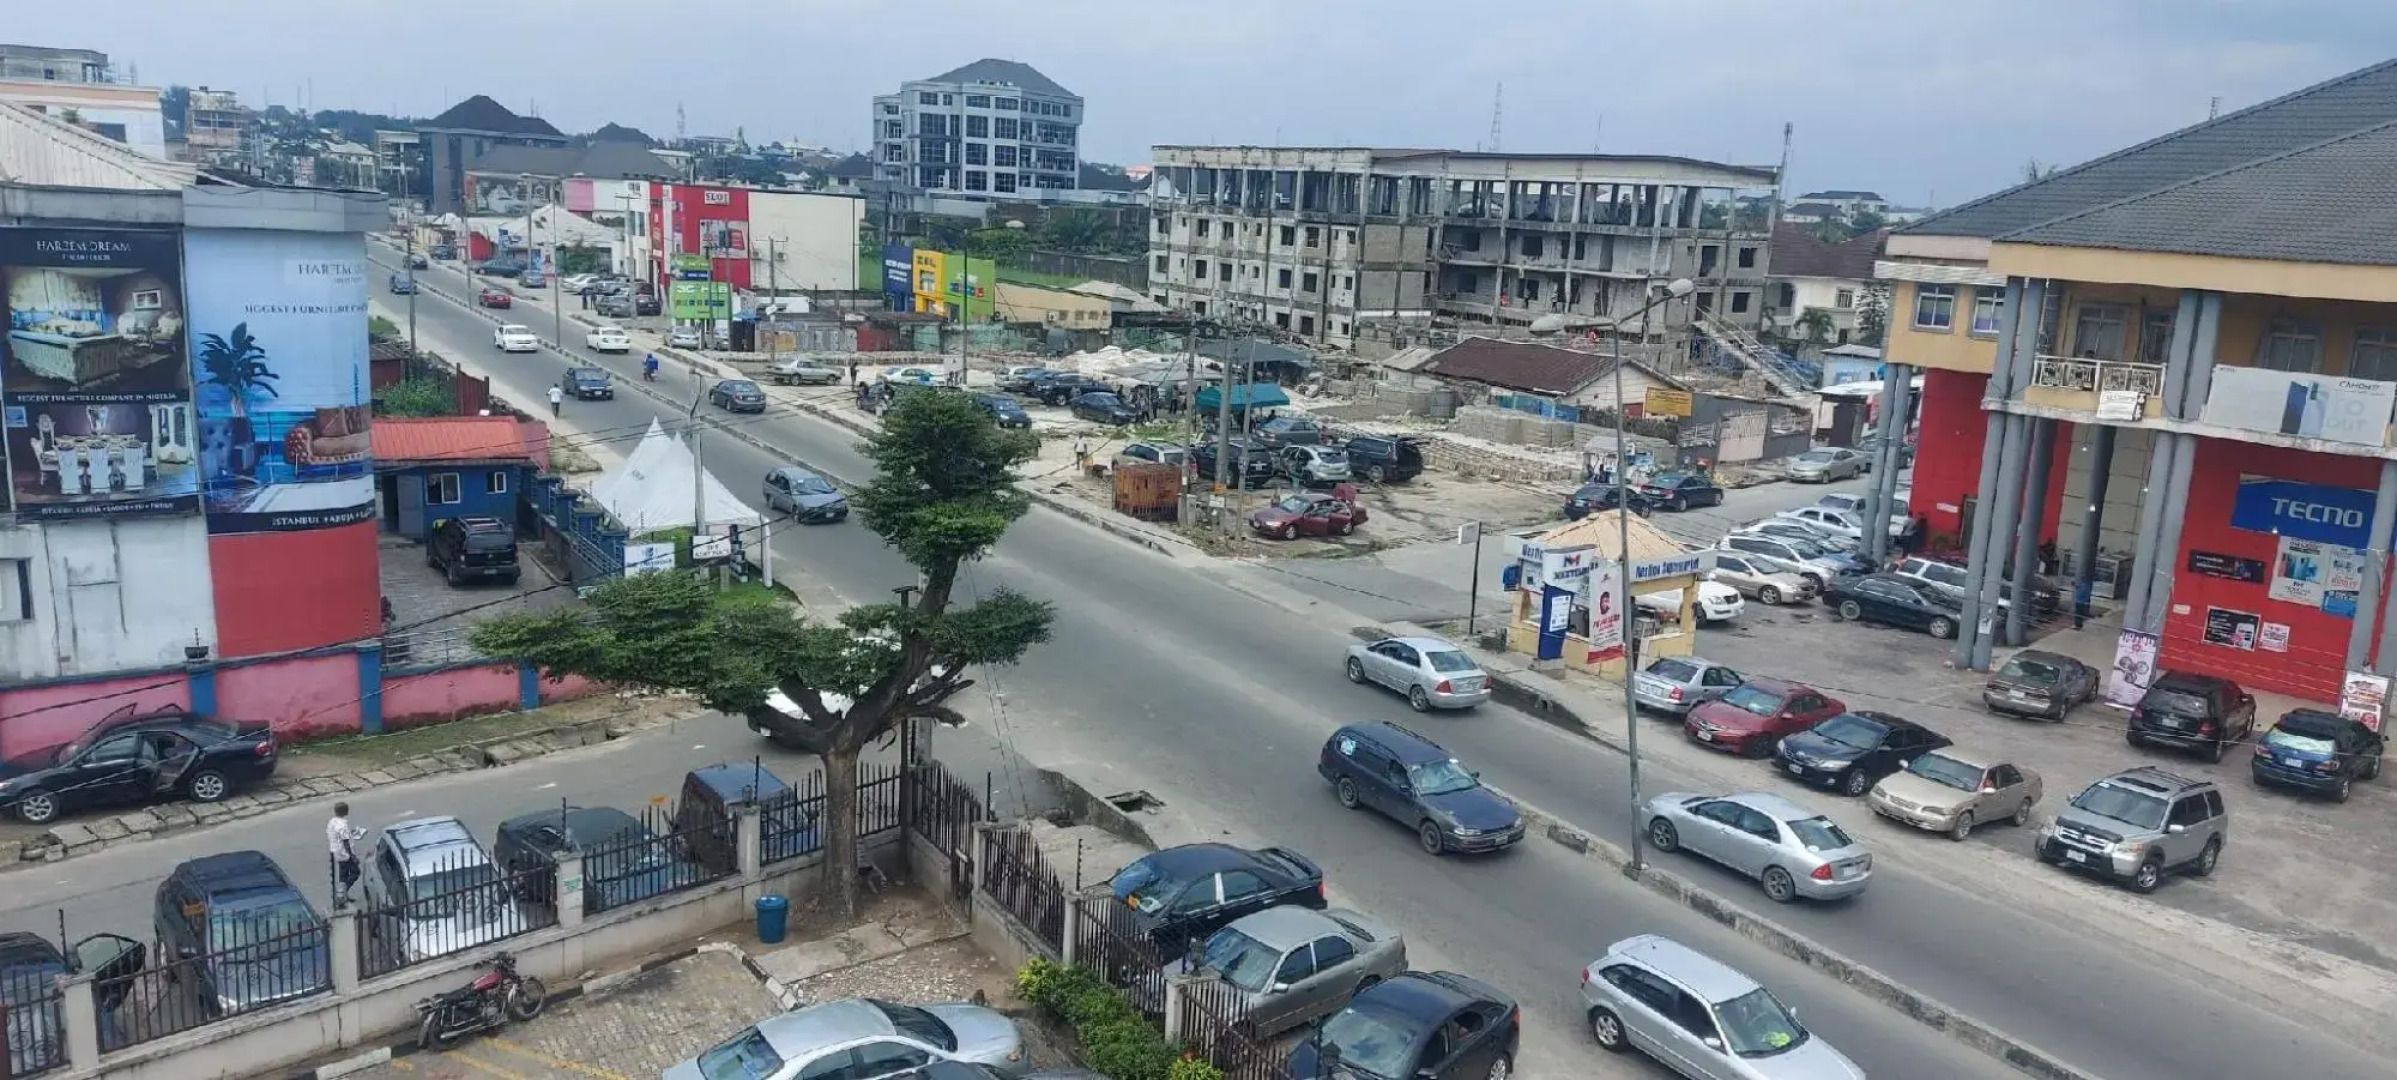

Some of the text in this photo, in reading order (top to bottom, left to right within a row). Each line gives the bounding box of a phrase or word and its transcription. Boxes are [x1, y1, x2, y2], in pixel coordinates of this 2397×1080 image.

[706, 192, 728, 201] SLOT
[89, 241, 131, 251] DREAM
[2270, 497, 2363, 528] TECNO
[272, 516, 319, 526] ISTANBUL
